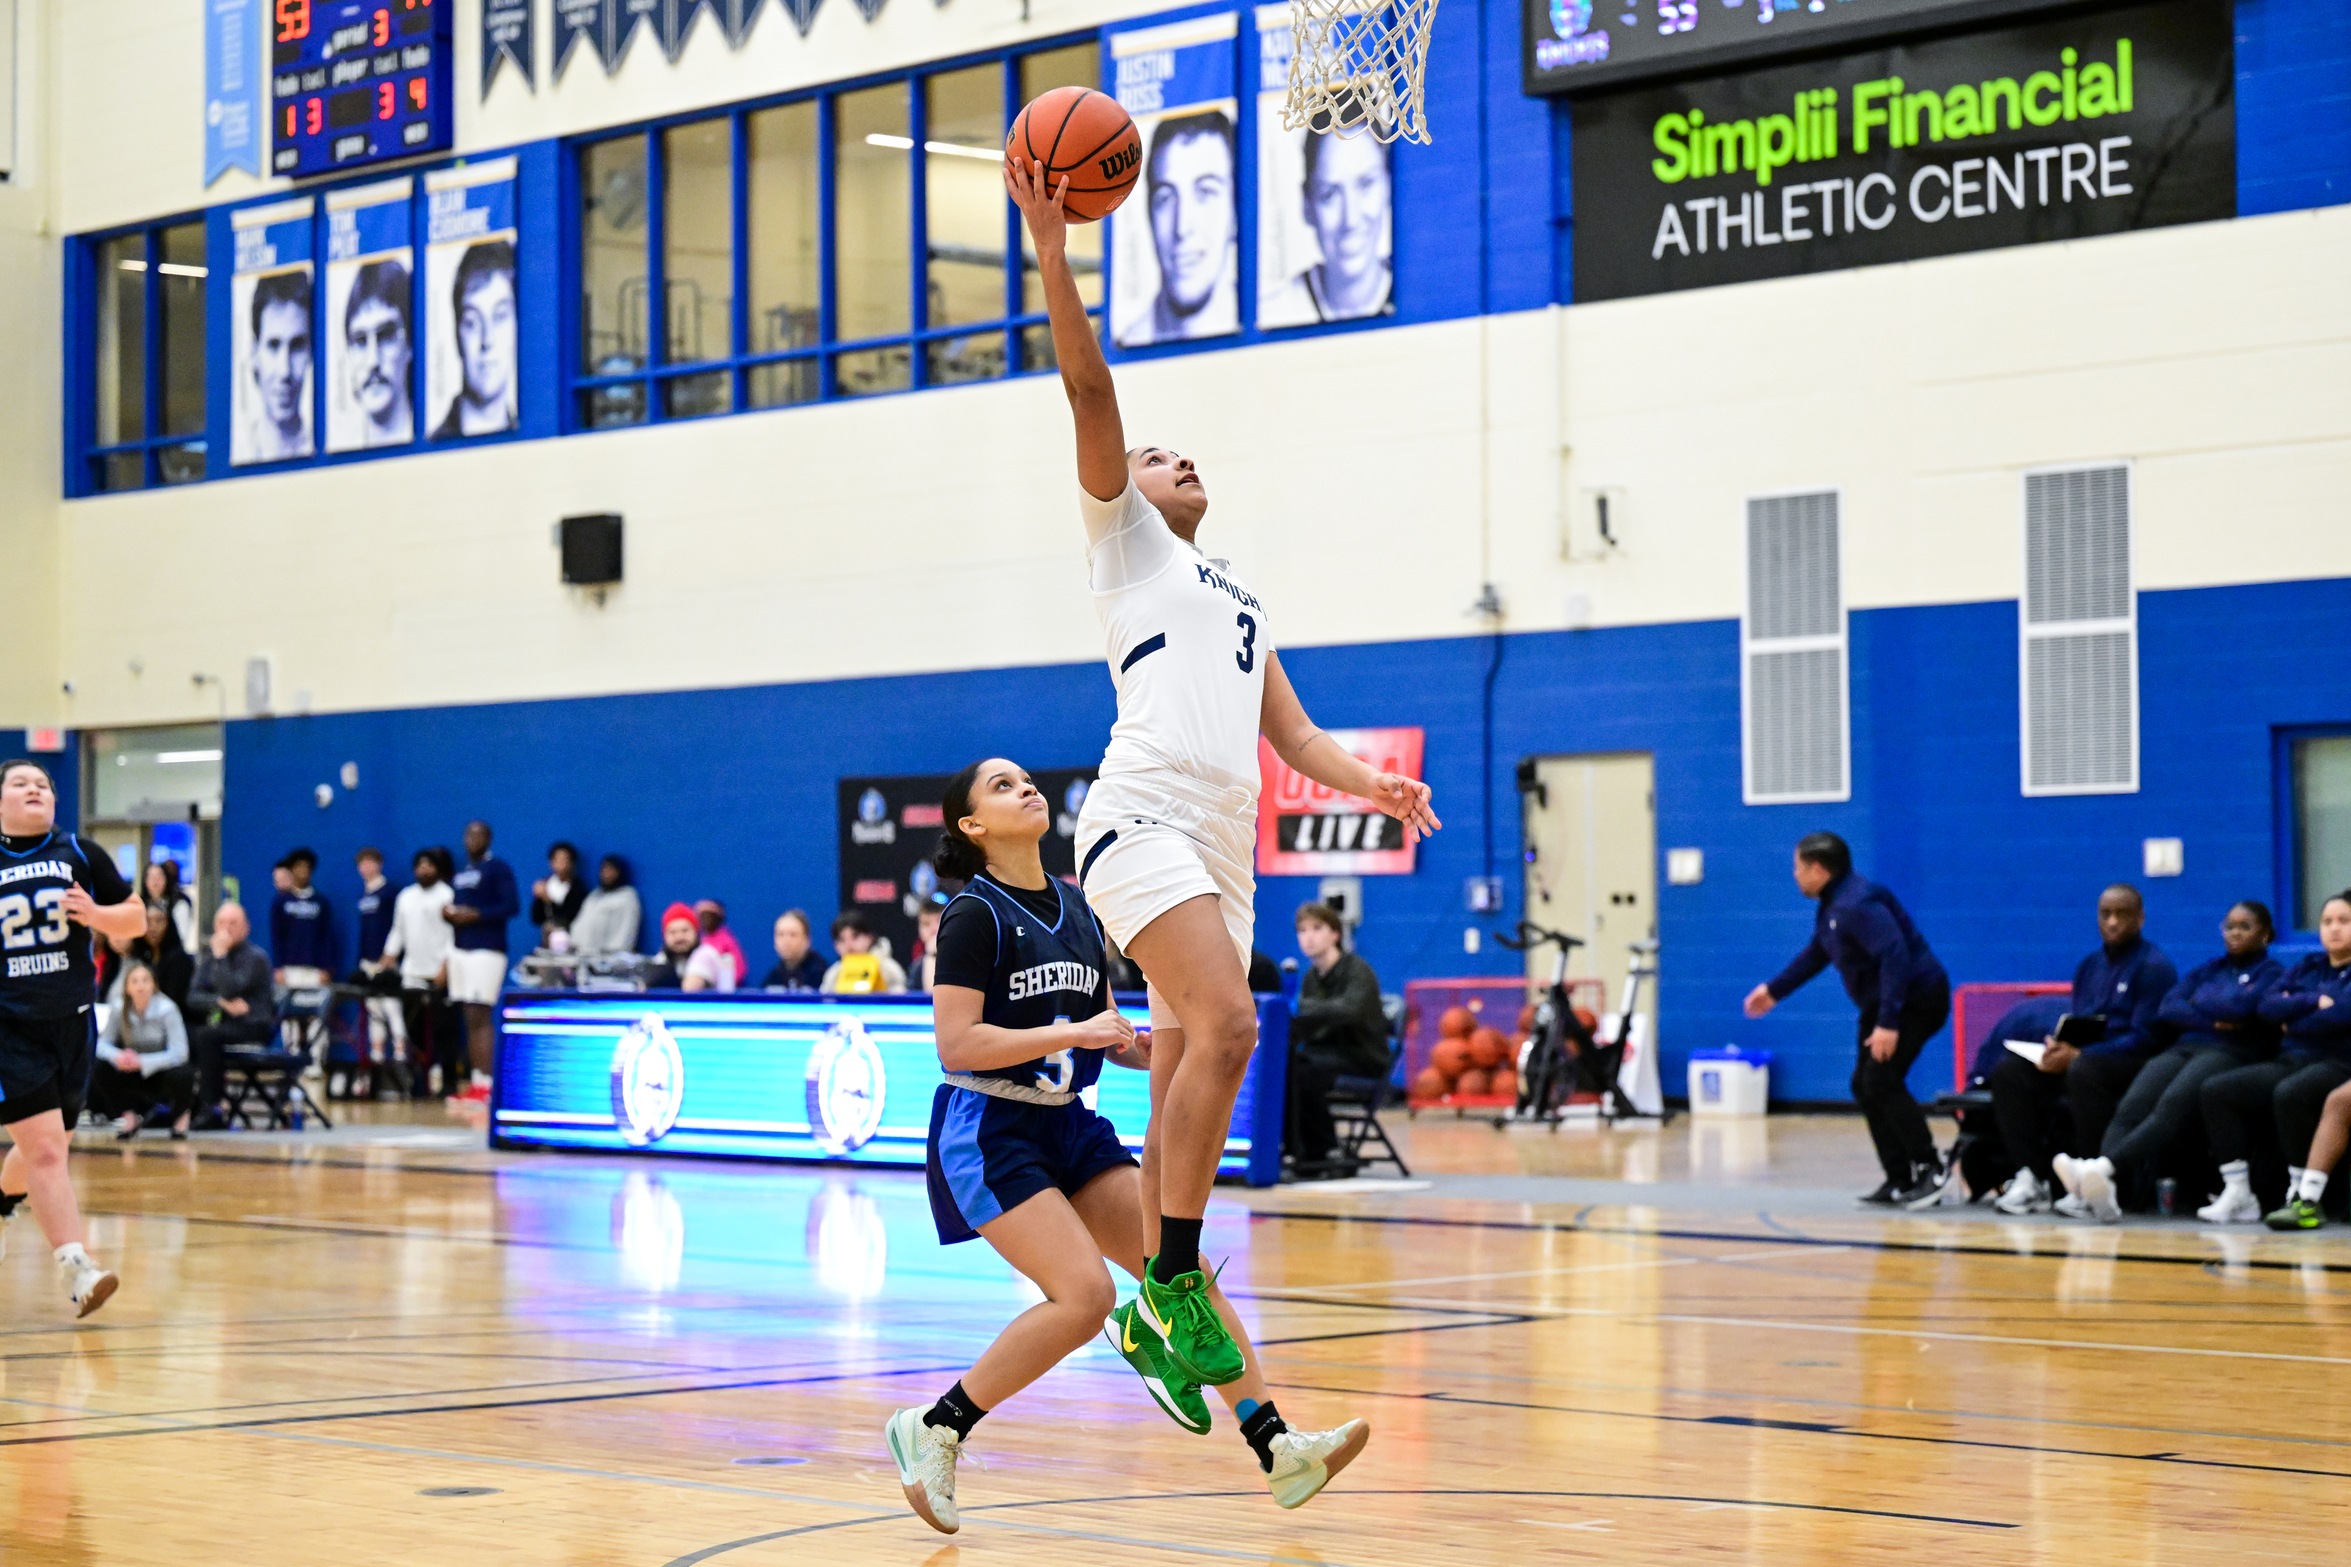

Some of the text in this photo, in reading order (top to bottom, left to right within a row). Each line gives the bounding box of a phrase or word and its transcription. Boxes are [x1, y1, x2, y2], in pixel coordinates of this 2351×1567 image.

[373, 9, 389, 47] 3
[287, 104, 296, 137] 1
[307, 97, 322, 135] 3
[378, 82, 395, 120] 3
[1652, 37, 2133, 187] Simplii Financial
[1098, 142, 1142, 181] Wils
[1652, 135, 2134, 260] ATHLETIC CENTRE
[1194, 563, 1268, 622] KNIGH
[1236, 611, 1256, 674] 3
[1294, 812, 1386, 851] LIVE
[0, 888, 70, 950] 23
[8, 951, 69, 977] BRUINS
